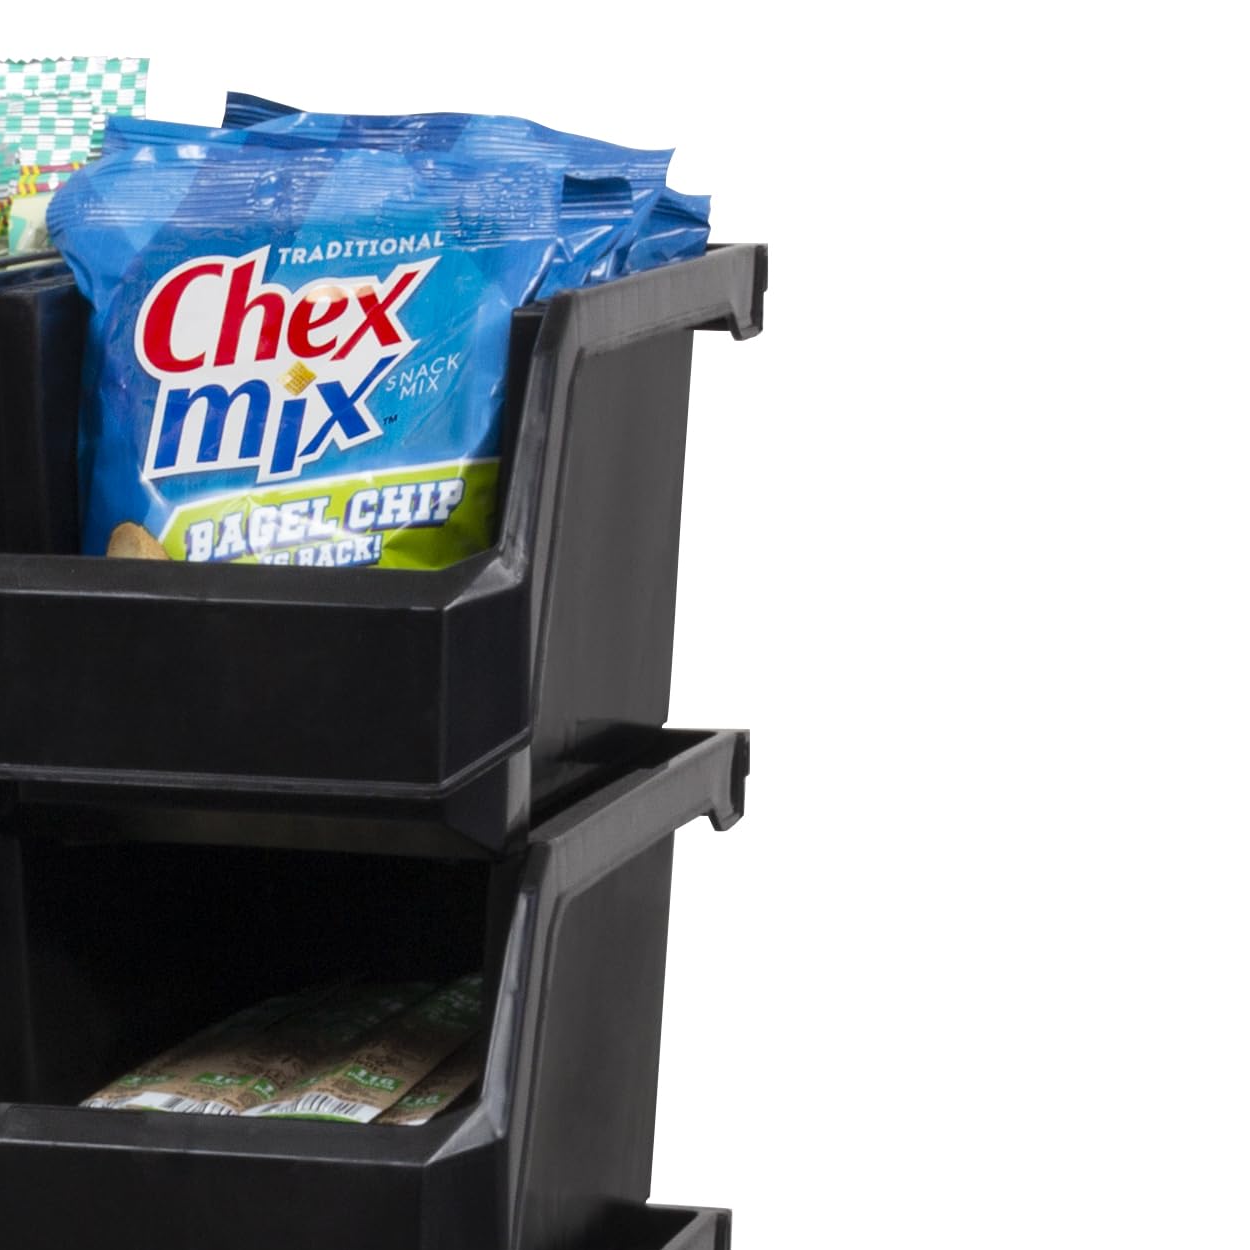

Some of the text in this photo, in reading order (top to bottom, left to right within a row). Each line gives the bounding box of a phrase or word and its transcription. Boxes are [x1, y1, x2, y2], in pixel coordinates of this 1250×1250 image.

[278, 230, 445, 265] TRADITIONAL
[141, 260, 421, 373] Chex
[385, 352, 461, 392] SNACK
[400, 373, 440, 401] MIX
[152, 354, 400, 474] mix
[186, 479, 465, 563] BAGEL CHIP
